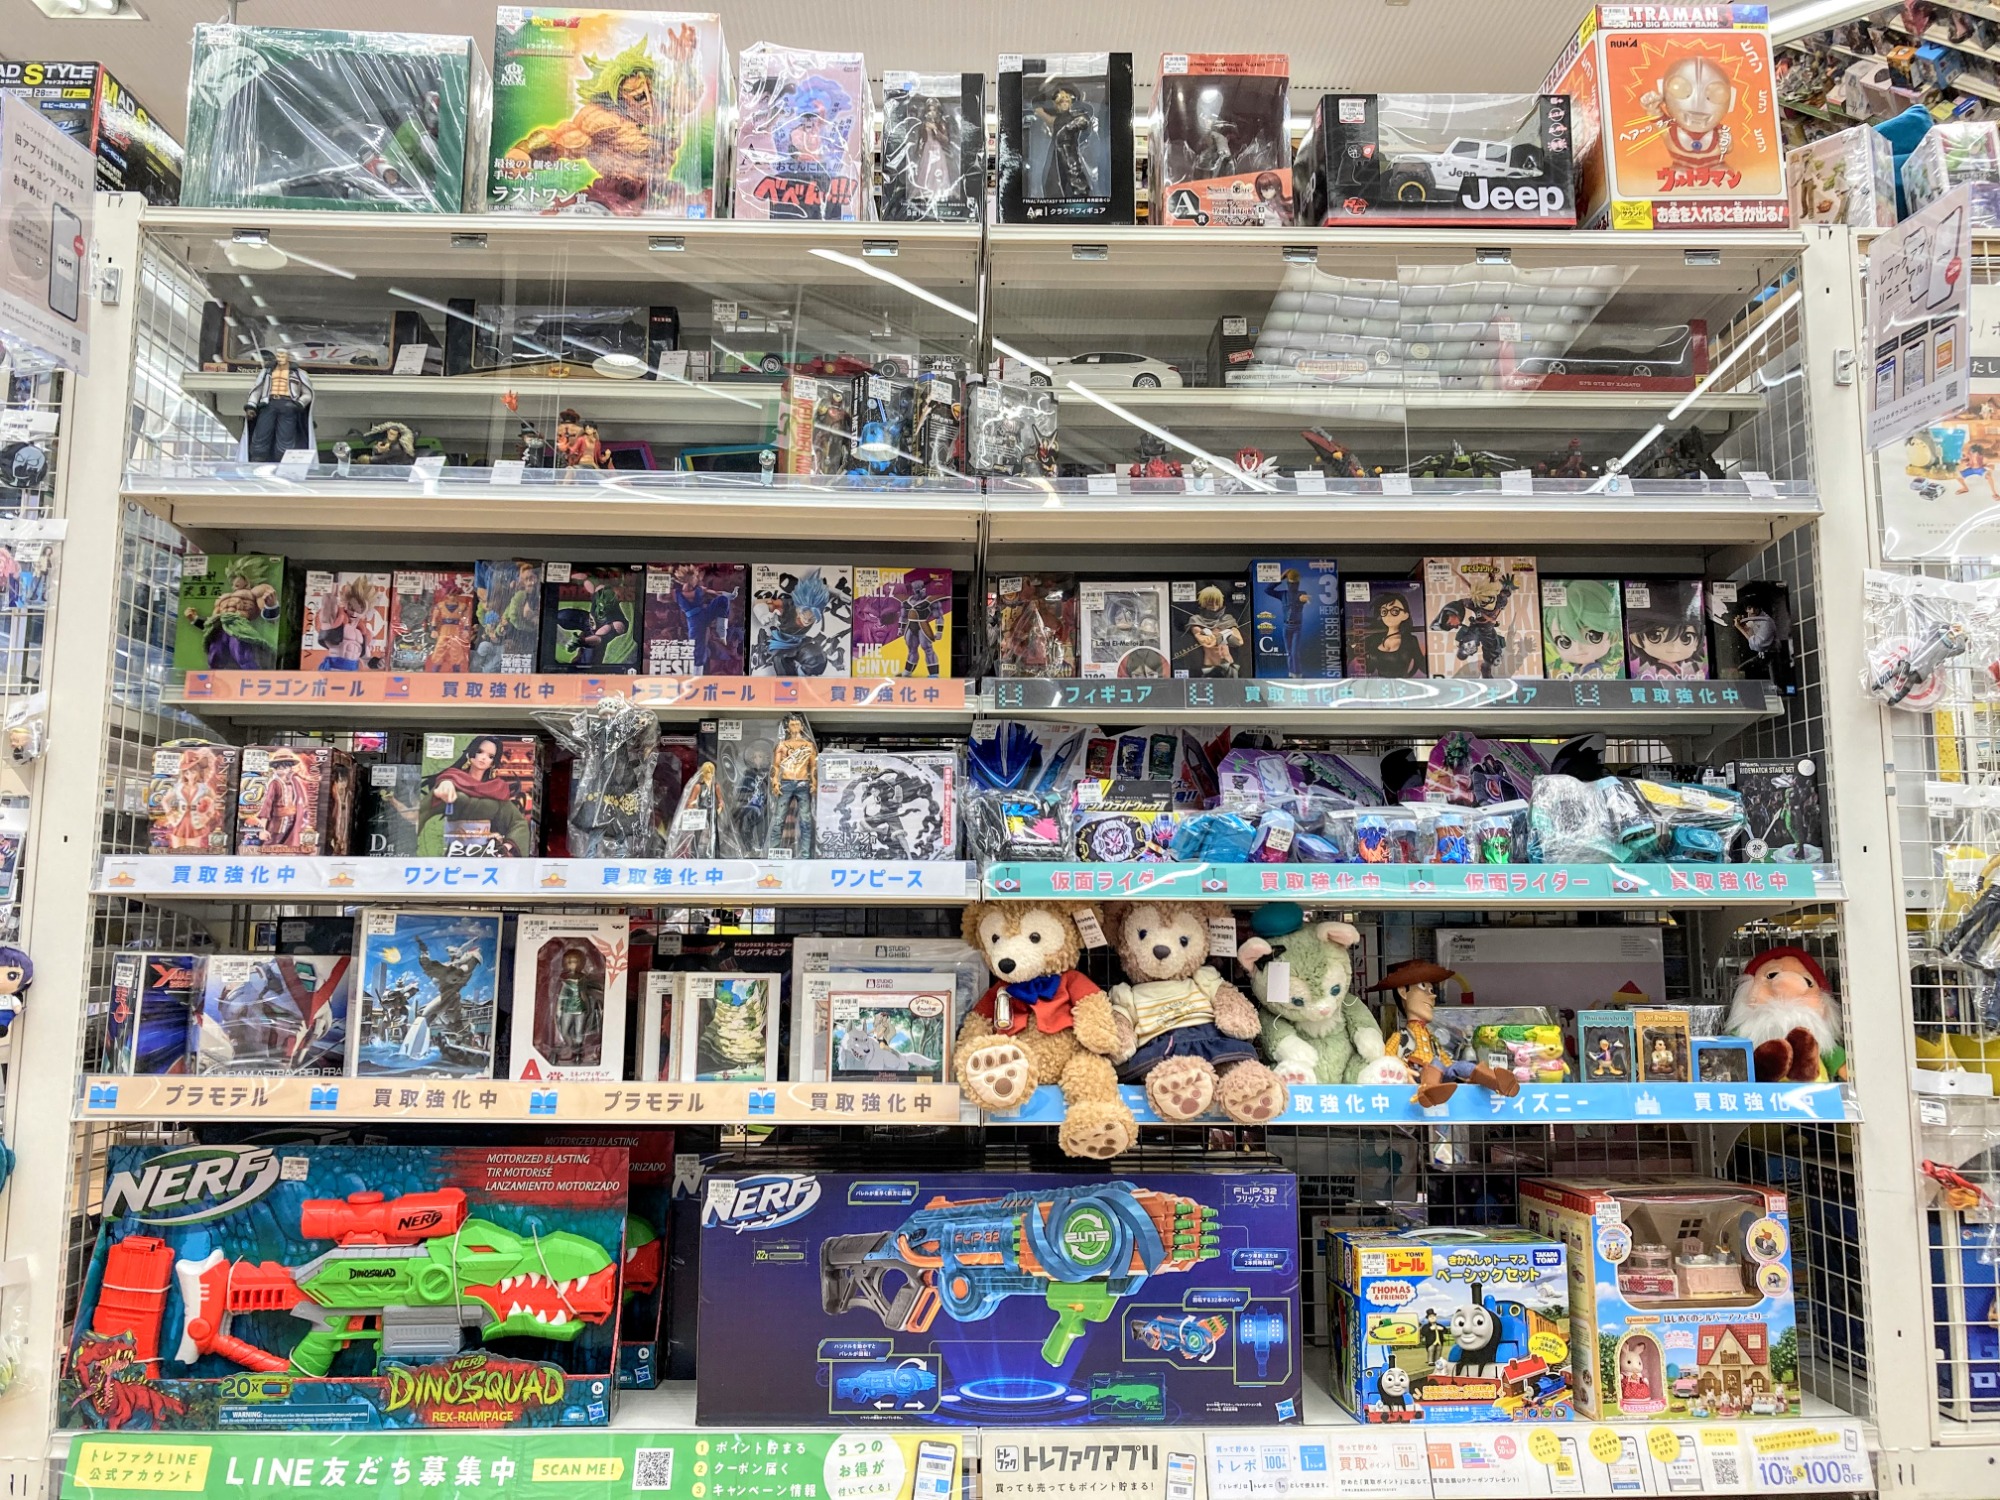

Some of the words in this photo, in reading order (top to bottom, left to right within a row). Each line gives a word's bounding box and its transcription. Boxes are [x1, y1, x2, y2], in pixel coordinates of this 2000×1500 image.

[1662, 21, 1696, 29] MONEY
[1698, 21, 1719, 29] BANK
[23, 63, 94, 85] STYLE
[494, 157, 580, 173] 最後の1個を引くと
[1656, 167, 1742, 192] ウルトラマン
[1461, 177, 1565, 216] Jeep
[1656, 204, 1784, 223] お金を入れると音が出る!
[1319, 574, 1338, 605] 3
[1319, 605, 1339, 615] HERO
[1324, 618, 1340, 640] BEST
[857, 643, 883, 658] THE
[856, 659, 900, 675] GINYU
[238, 677, 366, 698] ドラゴンボール
[441, 680, 555, 700] 買取強化中
[829, 685, 940, 704] 買取強化中
[1065, 685, 1154, 704] フィギュア
[1245, 685, 1356, 704] 買取強化中
[1629, 687, 1740, 704] 買取強化中
[1769, 766, 1784, 774] STAGE
[171, 865, 297, 884] 買取強化中
[404, 867, 499, 885] ワンピース
[602, 867, 724, 886] 買取強化中
[830, 868, 923, 888] ワンピース
[1050, 870, 1177, 892] 仮面ライダー
[1260, 871, 1382, 891] 買取強化中
[1464, 871, 1591, 892] 仮面ライダー
[1670, 872, 1789, 892] 買取強化中
[734, 948, 786, 956] ビッグフィギュア
[166, 1085, 269, 1107] プラモデル
[372, 1087, 499, 1109] 買取強化中
[604, 1090, 705, 1112] プラモデル
[810, 1093, 933, 1113] 買取強化中
[1693, 1091, 1815, 1112] 買取強化中
[487, 1154, 543, 1165] MOTORIZED
[544, 1154, 591, 1165] BLASTING
[487, 1167, 502, 1178] TIR
[503, 1165, 554, 1178] MOTORISÉ
[103, 1148, 275, 1218] NERF
[485, 1181, 554, 1192] LANZAMIENTO
[556, 1181, 620, 1192] MOTORIZADO
[1233, 1186, 1278, 1195] FLIP-32
[703, 1175, 818, 1228] NERF
[1235, 1195, 1275, 1204] フリップ-32
[397, 1212, 443, 1231] NERF
[734, 1213, 778, 1235] ナーフ
[1448, 1254, 1529, 1266] きかんしゃトーマス
[1534, 1251, 1559, 1259] TAKARA
[1535, 1257, 1559, 1265] TOMY
[349, 1267, 397, 1280] DINOSQUAD
[1387, 1259, 1427, 1273] レール
[1435, 1267, 1541, 1284] ベーシックセット
[1370, 1285, 1412, 1295] THOMAS
[452, 1355, 488, 1371] NERF
[384, 1365, 566, 1412] DINOSQUAD
[431, 1411, 514, 1423] REX-RAMPAGE
[715, 1441, 807, 1455] ポイント貯まる
[838, 1440, 884, 1457] 3つの
[91, 1449, 198, 1466] トレファクLINE
[1023, 1444, 1159, 1472] トレファクアプリ
[1216, 1458, 1257, 1474] トレポ
[90, 1467, 194, 1484] 公式アカウント
[225, 1455, 517, 1488] LINE友だち募集中
[541, 1463, 582, 1476] SCAN
[584, 1463, 615, 1475] ME!
[713, 1462, 789, 1476] クーポン届く
[838, 1460, 885, 1478] お得が
[1842, 1473, 1864, 1484] OFF
[712, 1484, 817, 1498] キャンペーン情報
[837, 1482, 892, 1497] 付いてくる!
[995, 1482, 1155, 1494] 買っても売ってもポイント貯まる!
